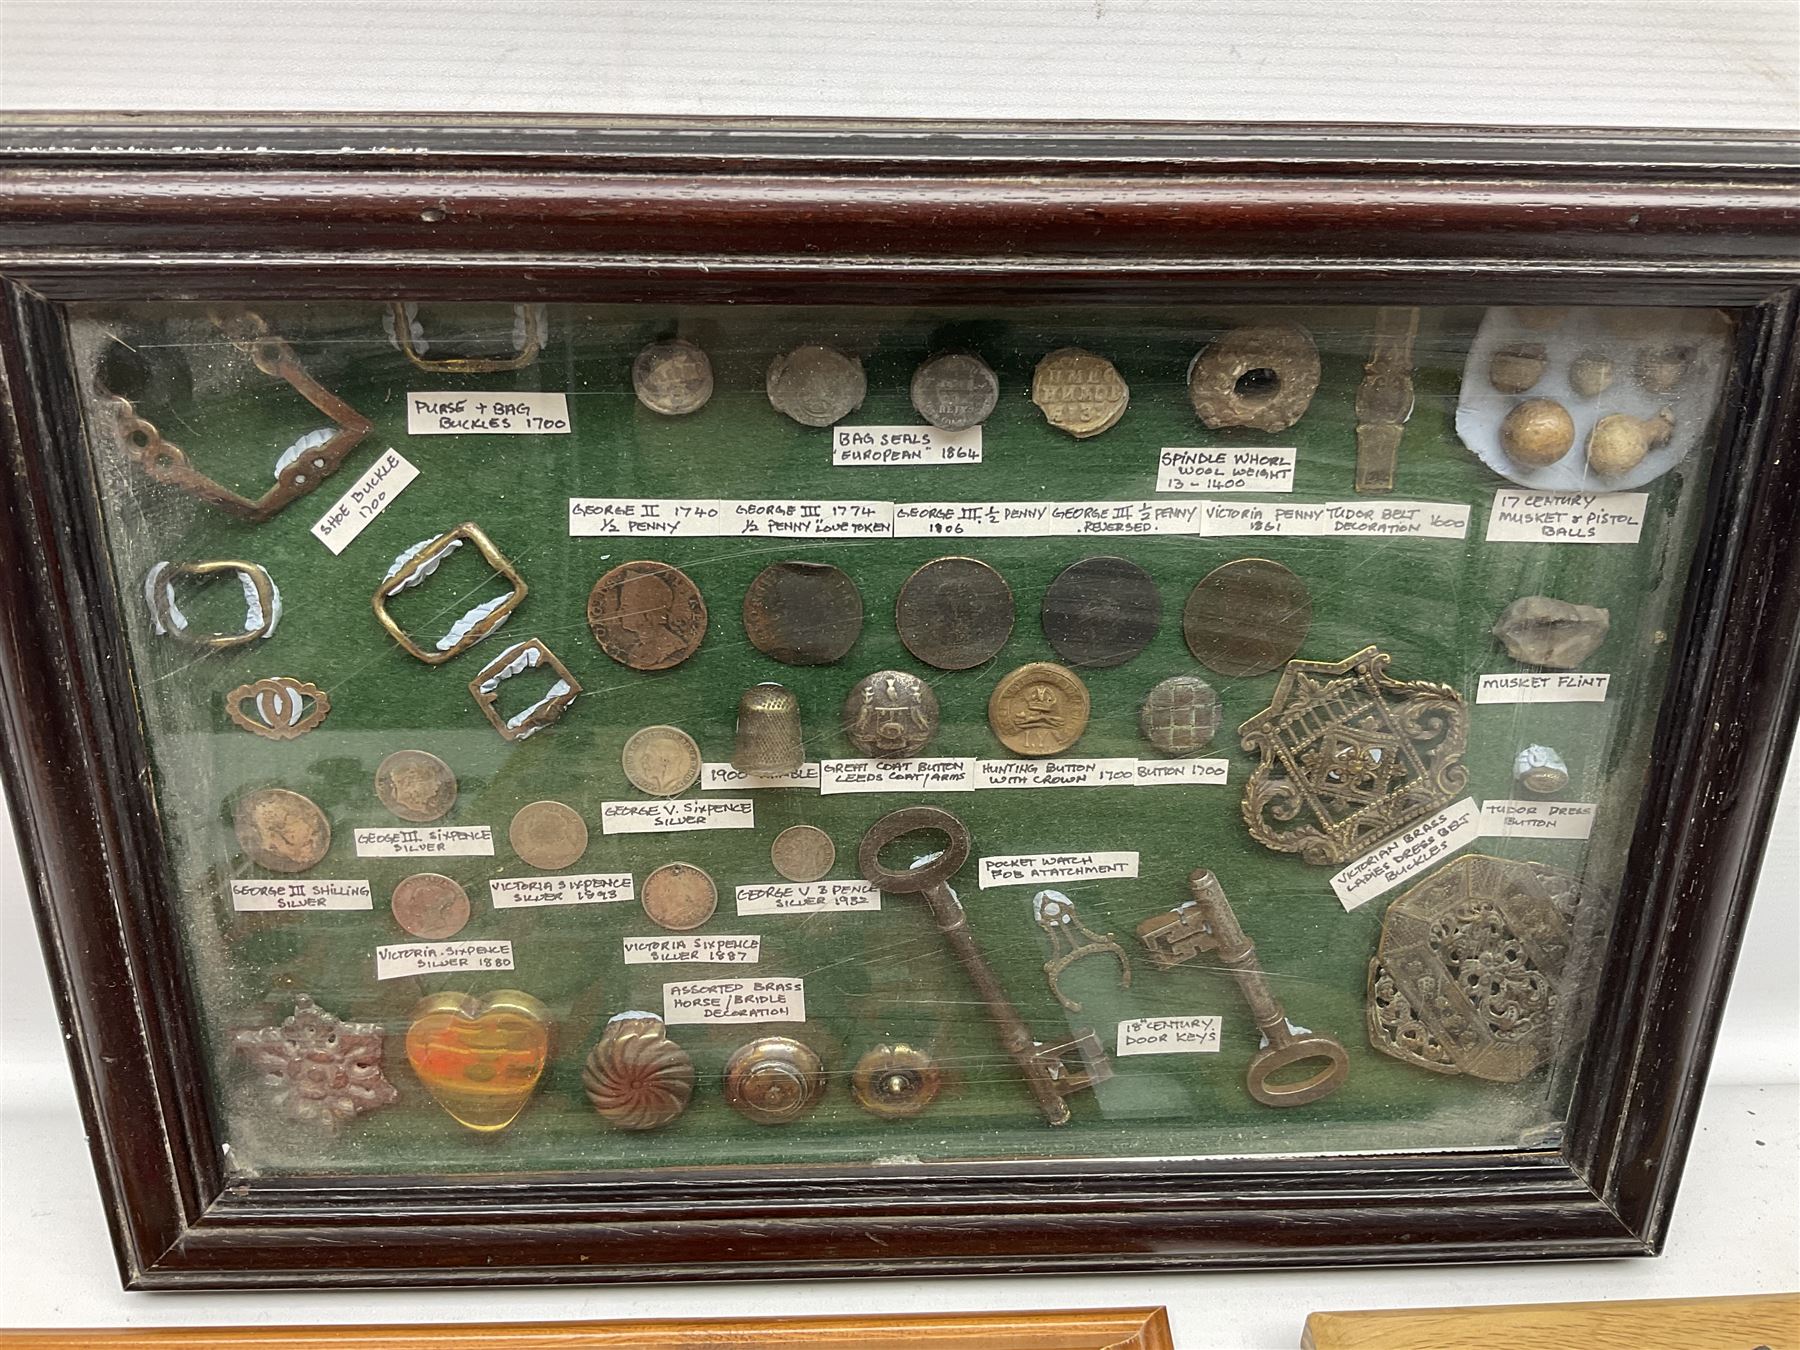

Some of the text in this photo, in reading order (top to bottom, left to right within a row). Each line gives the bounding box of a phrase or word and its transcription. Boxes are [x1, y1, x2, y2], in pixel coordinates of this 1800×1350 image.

[415, 400, 467, 414] PURSE
[493, 402, 530, 416] BAG
[440, 417, 566, 429] BUCKLES 1700
[839, 432, 930, 446] BAG SEALS
[942, 447, 979, 459] 1864
[1234, 453, 1290, 466] WHORL
[1178, 466, 1224, 476] WOOL
[351, 455, 399, 504] BUCKLE
[1168, 478, 1184, 489] 13
[1207, 479, 1245, 490] 1400
[1502, 496, 1519, 508] 17
[572, 504, 635, 517] GEORGE
[675, 506, 718, 518] 1740
[736, 504, 796, 516] GEORGE
[833, 506, 875, 517] 1774
[897, 508, 954, 520] GEORGE
[1005, 507, 1047, 520] PENNY
[1052, 507, 1109, 519] GEORGE
[1155, 507, 1197, 522] PENNY
[1275, 509, 1323, 521] PENNY
[1326, 507, 1420, 520] TUDOR BELT
[1499, 512, 1568, 524] MUSKET
[629, 521, 680, 534] PENNY
[768, 520, 811, 533] PENNY
[852, 523, 890, 533] TOKEN
[1250, 521, 1281, 531] 1861
[1542, 526, 1596, 537] BALLS
[876, 762, 912, 771] COAT
[918, 762, 963, 772] BUTTON
[983, 763, 1095, 774] HUNTING BUTTON
[1138, 765, 1225, 777] BUTTON 1700
[712, 769, 748, 781] 1900
[835, 773, 883, 782] LEEDS
[990, 774, 1086, 784] WITH CROWN
[1100, 771, 1132, 780] 1700
[605, 806, 660, 816] GEORGE
[1486, 805, 1591, 815] TUDOR DRESS
[654, 816, 706, 825] SILVER
[1504, 817, 1557, 827] BUTTON
[1403, 814, 1448, 843] BRASS
[394, 843, 445, 852] SILVER
[1393, 836, 1435, 863] DRESS
[986, 856, 1093, 871] POCKET WATCH
[1385, 841, 1448, 882] BUCKLES
[991, 870, 1024, 879] FOB
[492, 881, 553, 891] VICTORIA
[737, 886, 794, 900] GEORGE
[832, 885, 878, 895] PENCE
[278, 898, 327, 908] SILVER
[776, 897, 825, 907] SILVER
[446, 945, 510, 956] SIXPENCE
[625, 938, 758, 952] VICTORIA SIXPENCE
[651, 951, 746, 960] SILVER 1887
[417, 958, 511, 968] SILVER 1880
[671, 983, 802, 995] ASSORTED BRASS
[704, 1007, 789, 1017] DECORATION
[1126, 1033, 1216, 1045] DOOR KEYS
